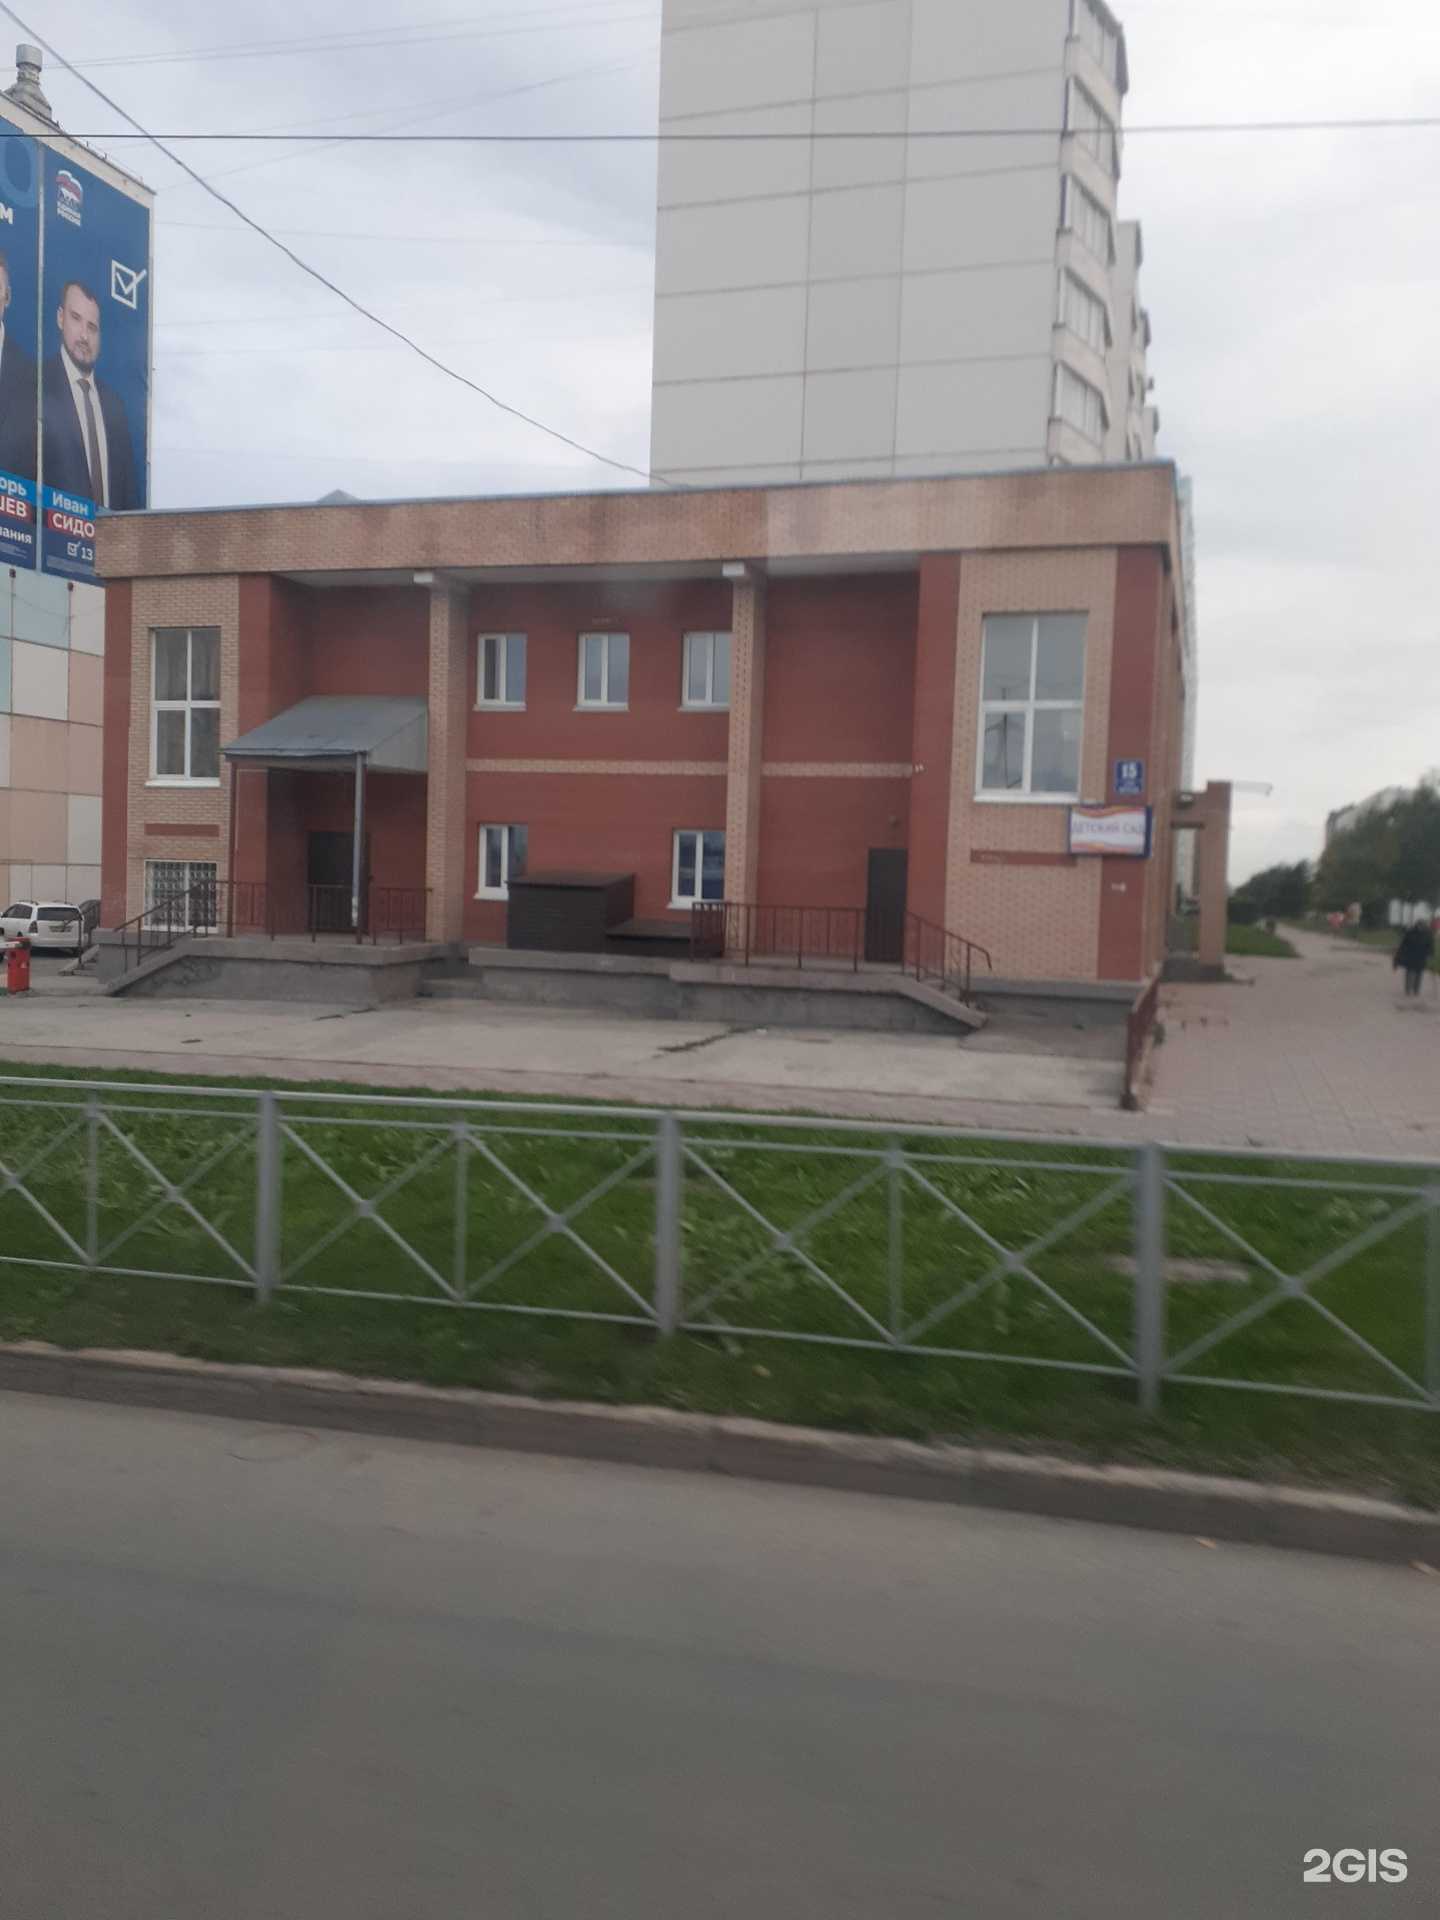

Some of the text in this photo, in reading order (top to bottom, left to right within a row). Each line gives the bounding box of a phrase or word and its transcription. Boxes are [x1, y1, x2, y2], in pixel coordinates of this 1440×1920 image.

[52, 491, 88, 516] Иван
[52, 512, 95, 538] СИДО
[81, 547, 93, 561] 13
